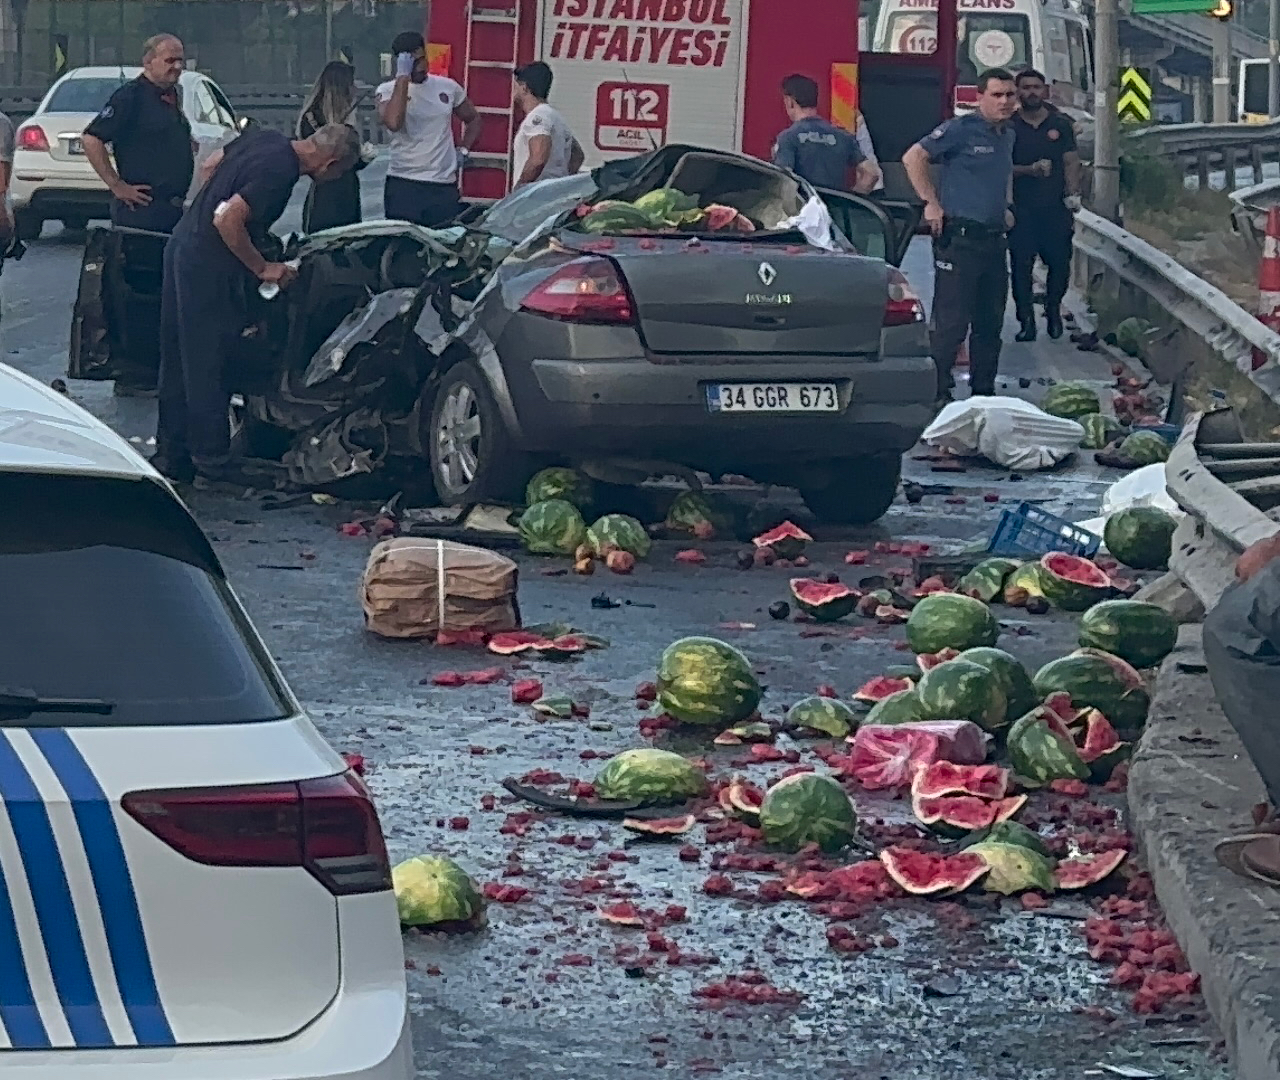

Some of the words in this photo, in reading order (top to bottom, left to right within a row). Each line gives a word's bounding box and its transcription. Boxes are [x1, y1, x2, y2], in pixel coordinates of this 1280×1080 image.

[909, 36, 938, 52] 112
[609, 88, 660, 121] 112
[722, 387, 746, 408] 34
[753, 386, 790, 408] GGR
[800, 386, 836, 408] 673
